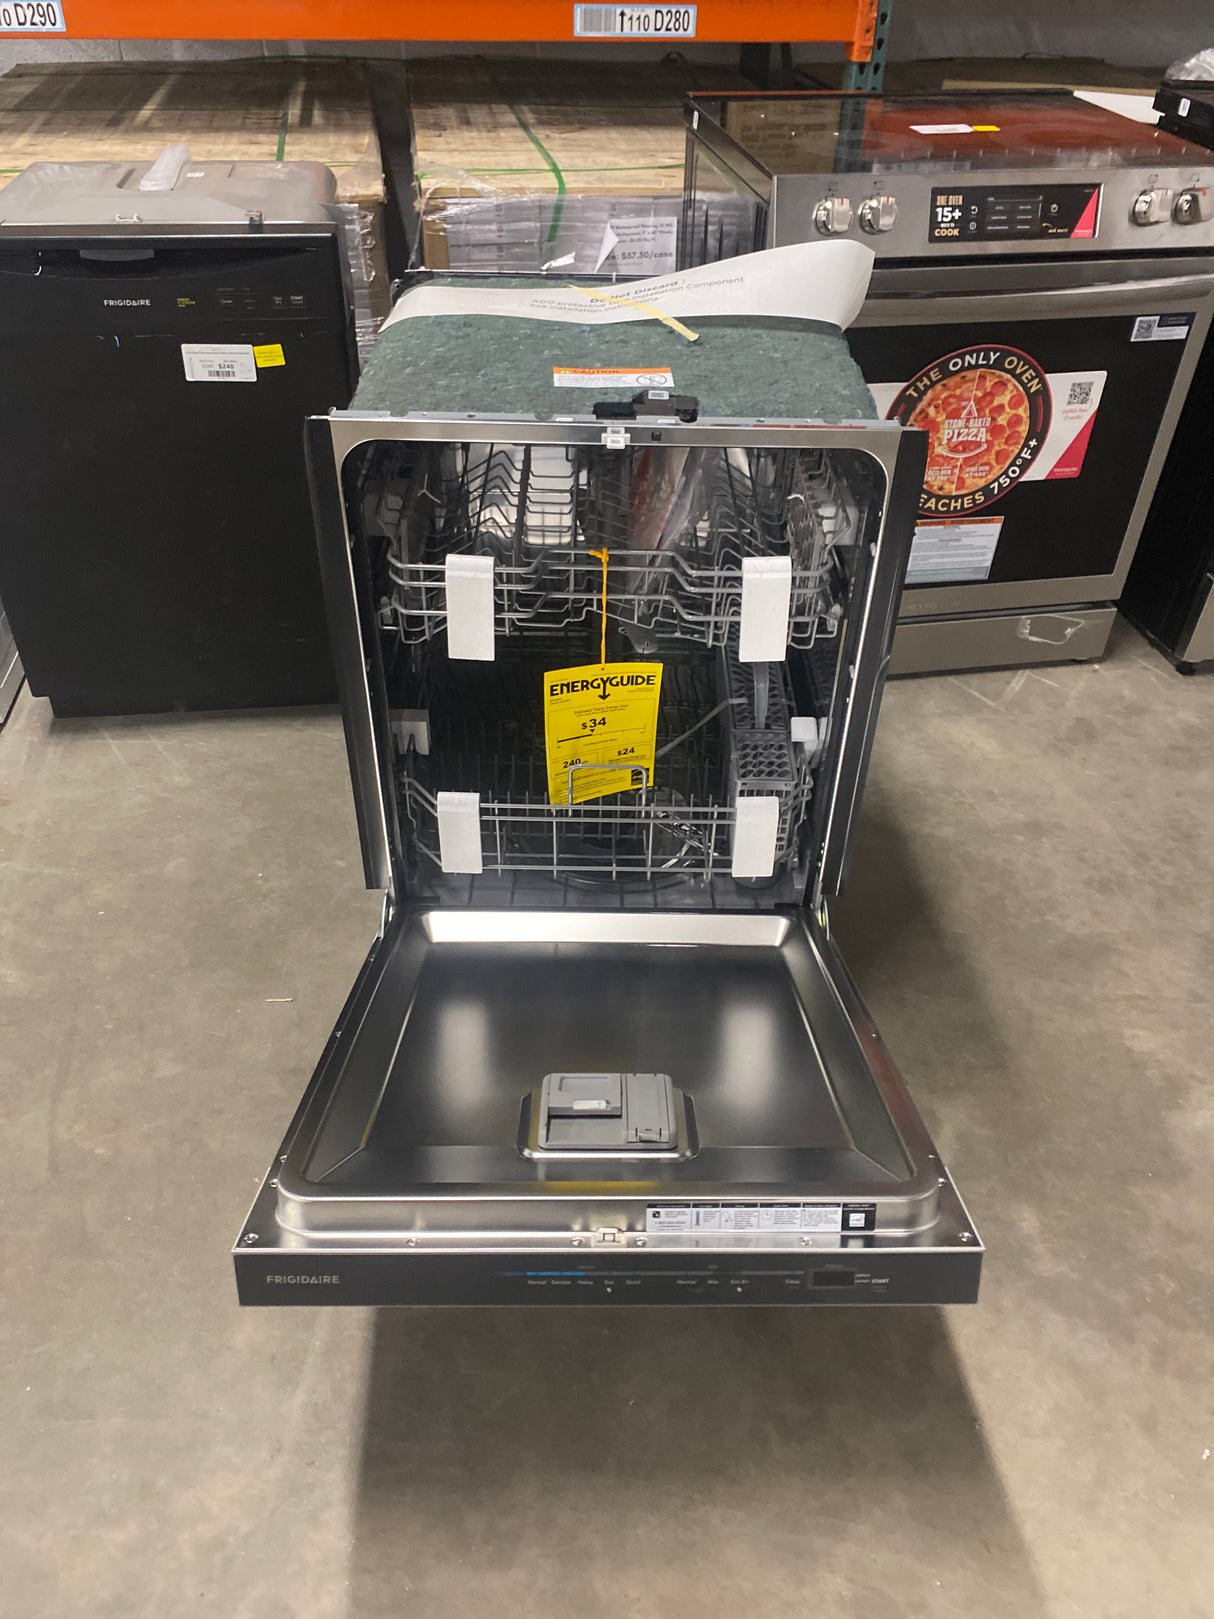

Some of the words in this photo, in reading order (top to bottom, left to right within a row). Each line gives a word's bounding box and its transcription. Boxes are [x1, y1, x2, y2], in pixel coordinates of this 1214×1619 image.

[13, 3, 57, 26] D290
[628, 14, 650, 31] 110
[654, 9, 690, 32] D280
[936, 207, 962, 222] 15+
[935, 228, 960, 237] COOK
[634, 281, 678, 295] Discard
[686, 276, 744, 290] Component
[103, 299, 152, 307] FRIGIDAIRE
[905, 367, 943, 398] THE
[948, 351, 1001, 371] ONLY
[941, 427, 987, 445] PIZZA
[919, 491, 985, 511] EACHES
[549, 674, 657, 700] ENERGYGUIDE
[581, 717, 607, 730] $34
[617, 747, 635, 756] $24
[266, 1275, 341, 1285] FRIGIDAIRE
